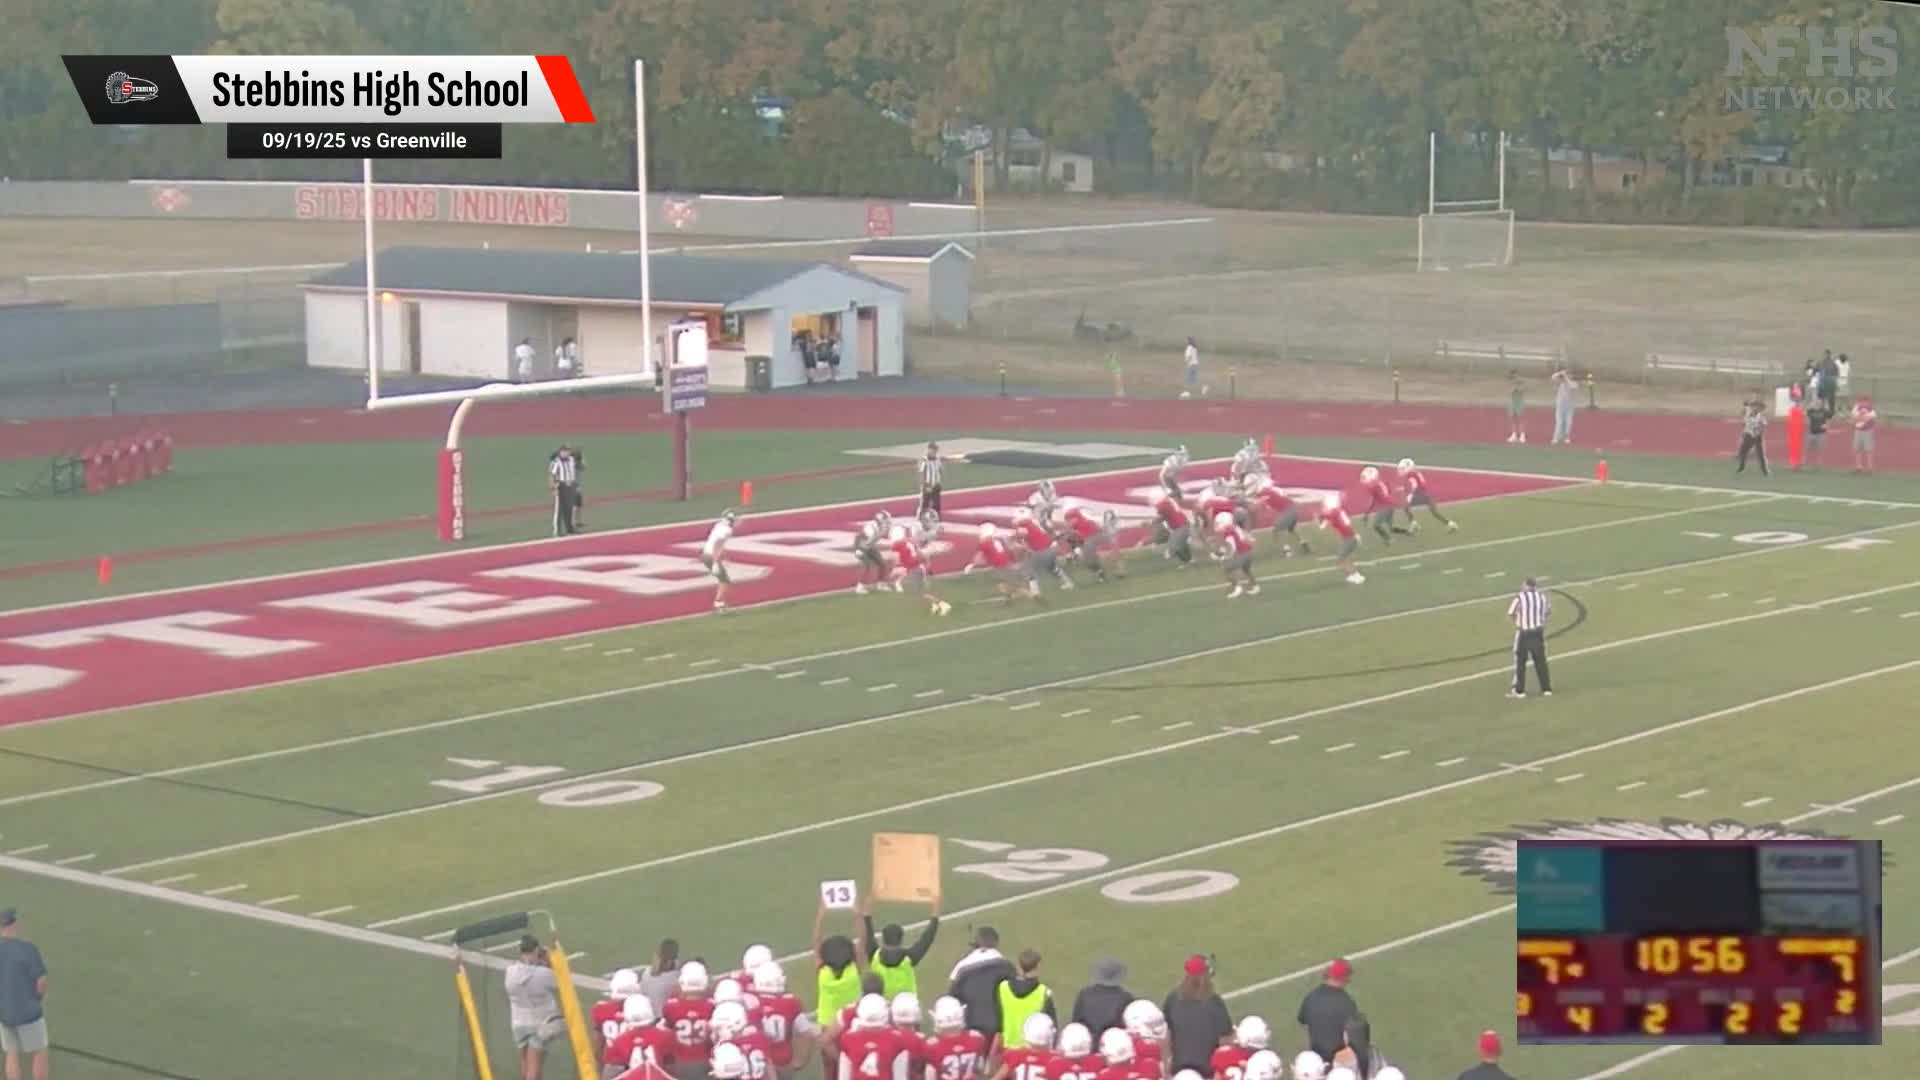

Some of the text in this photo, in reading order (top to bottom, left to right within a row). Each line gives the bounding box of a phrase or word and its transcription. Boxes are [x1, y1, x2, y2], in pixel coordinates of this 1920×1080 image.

[448, 190, 569, 227] INDIANS
[825, 886, 851, 903] 13
[1643, 1002, 1667, 1034] 2
[1726, 1002, 1749, 1034] 2
[1778, 1002, 1801, 1034] 2
[859, 1051, 880, 1077] 4
